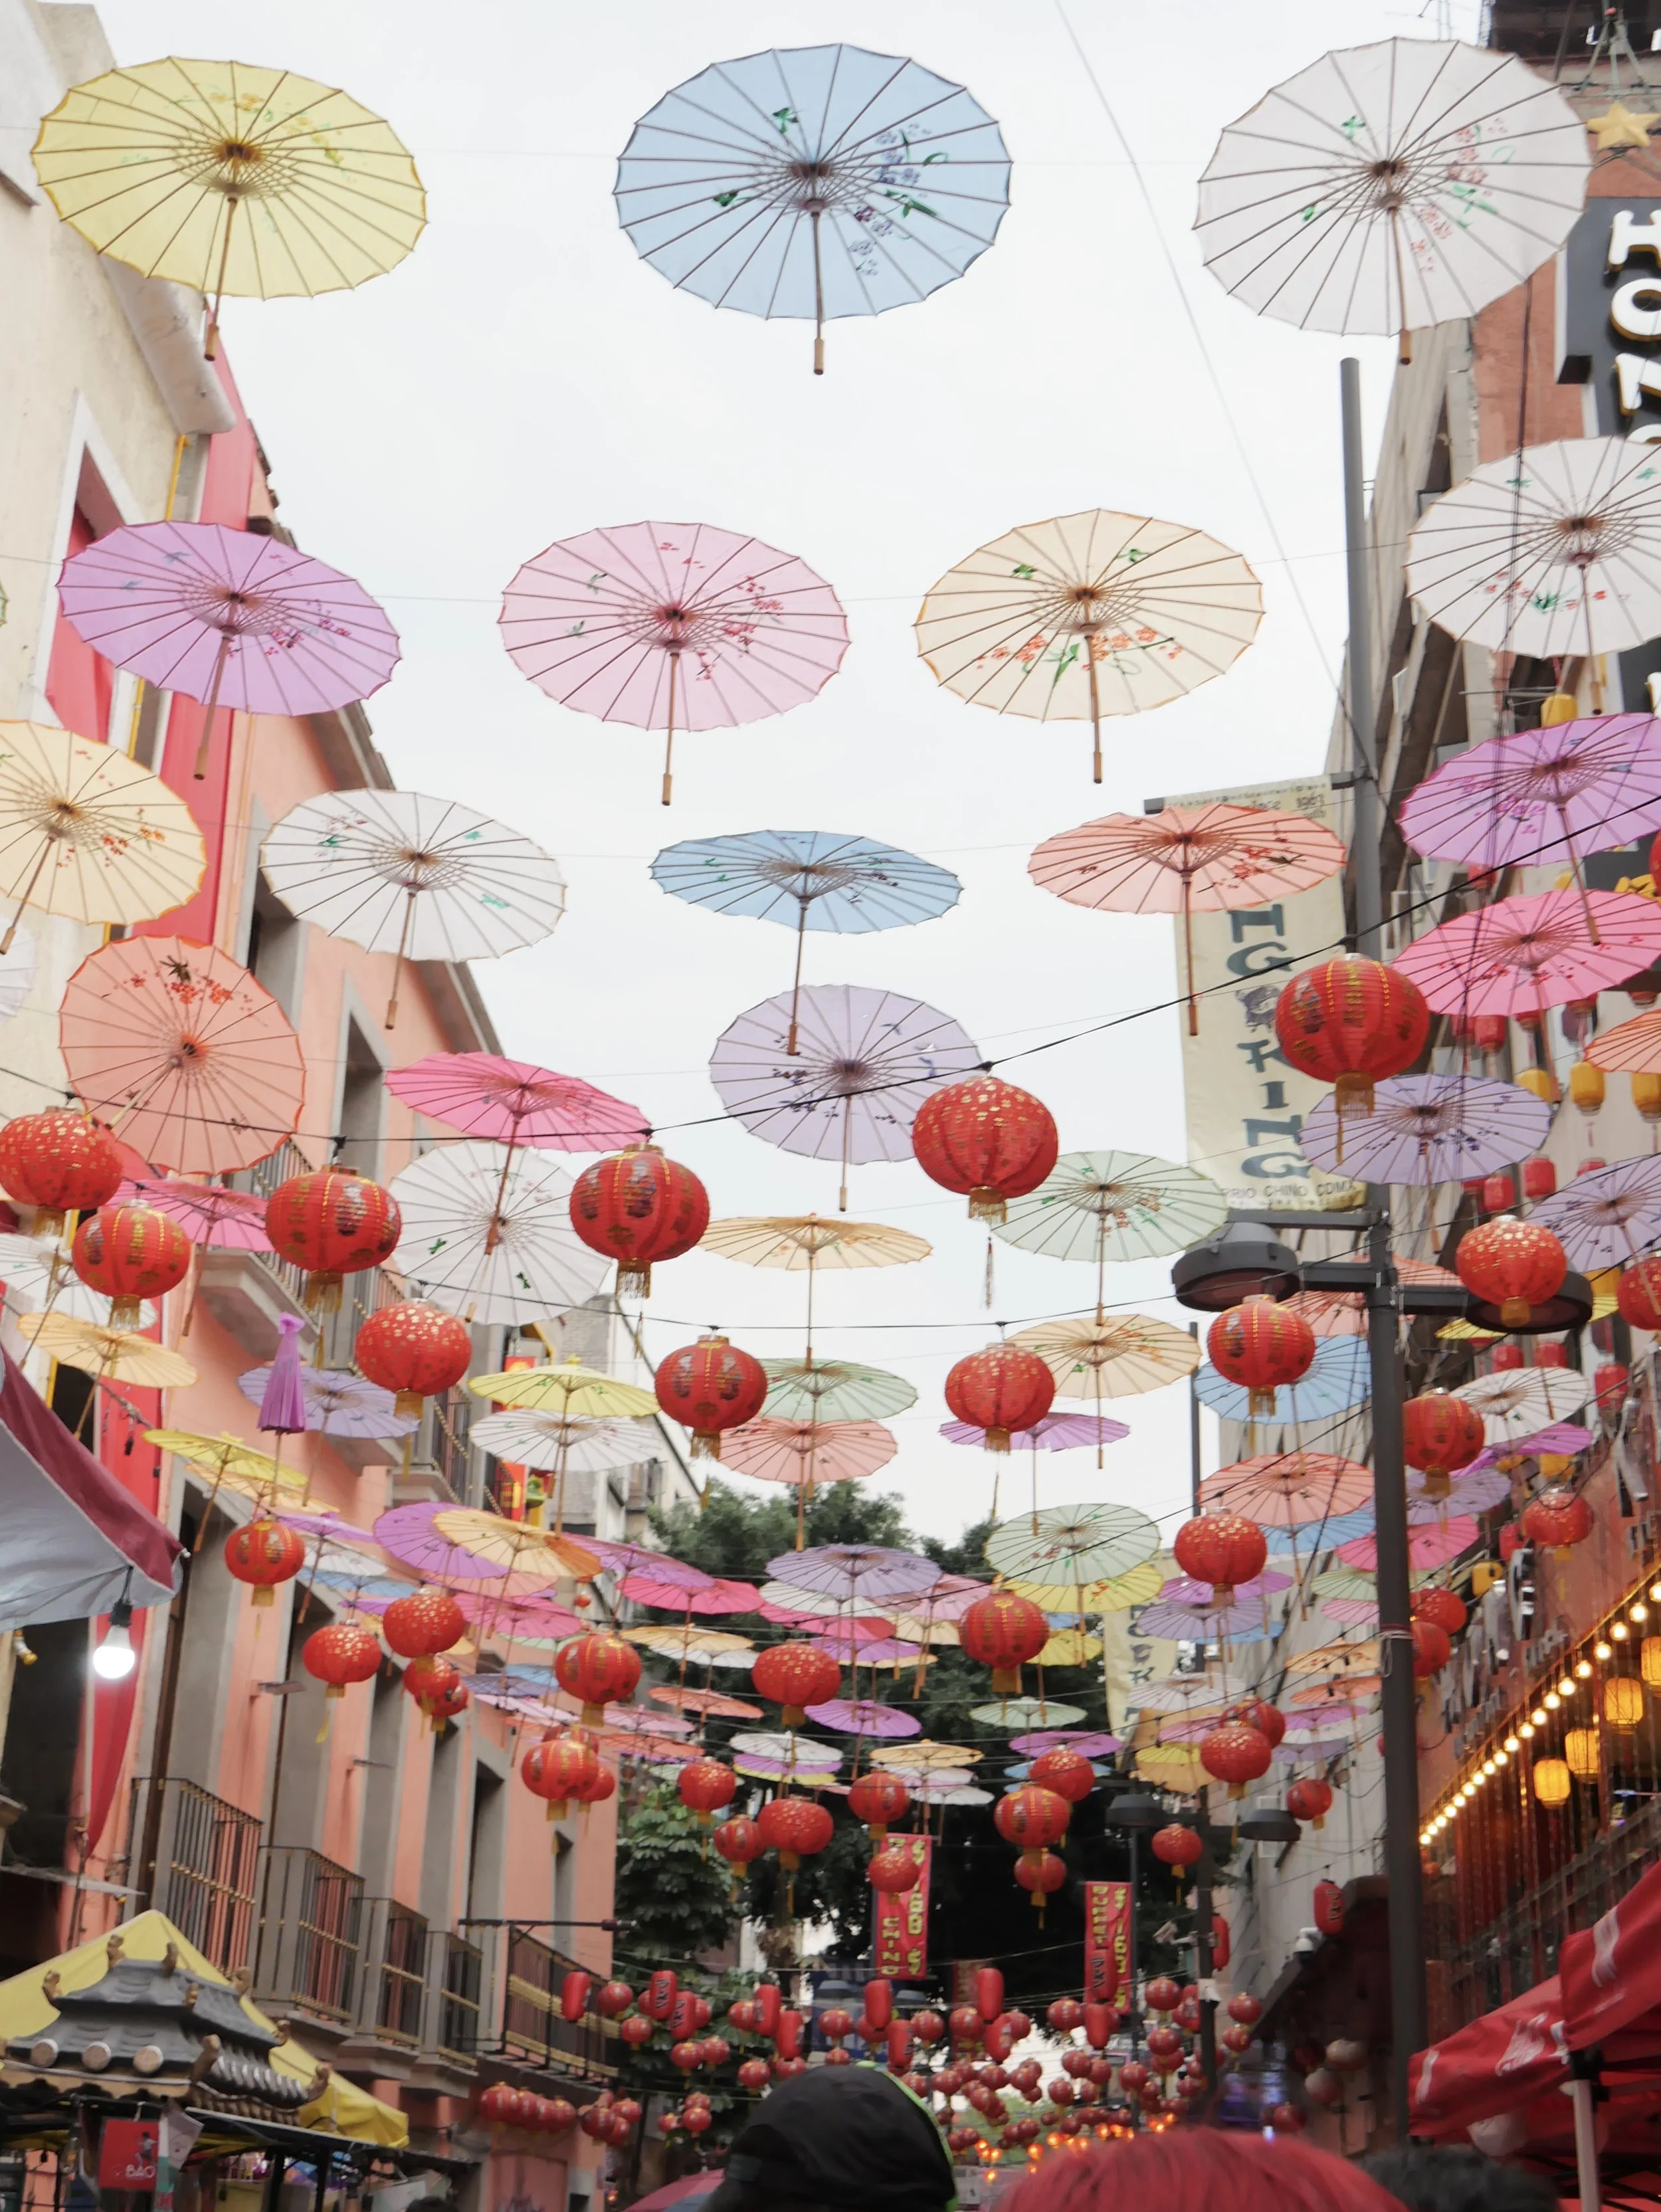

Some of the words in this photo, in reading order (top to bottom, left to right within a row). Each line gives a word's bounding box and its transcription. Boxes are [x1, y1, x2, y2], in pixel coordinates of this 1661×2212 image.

[1608, 209, 1661, 444] HON
[1237, 1039, 1312, 1179] KING
[1264, 1184, 1308, 1197] CHINO
[880, 1916, 900, 1975] CHINO
